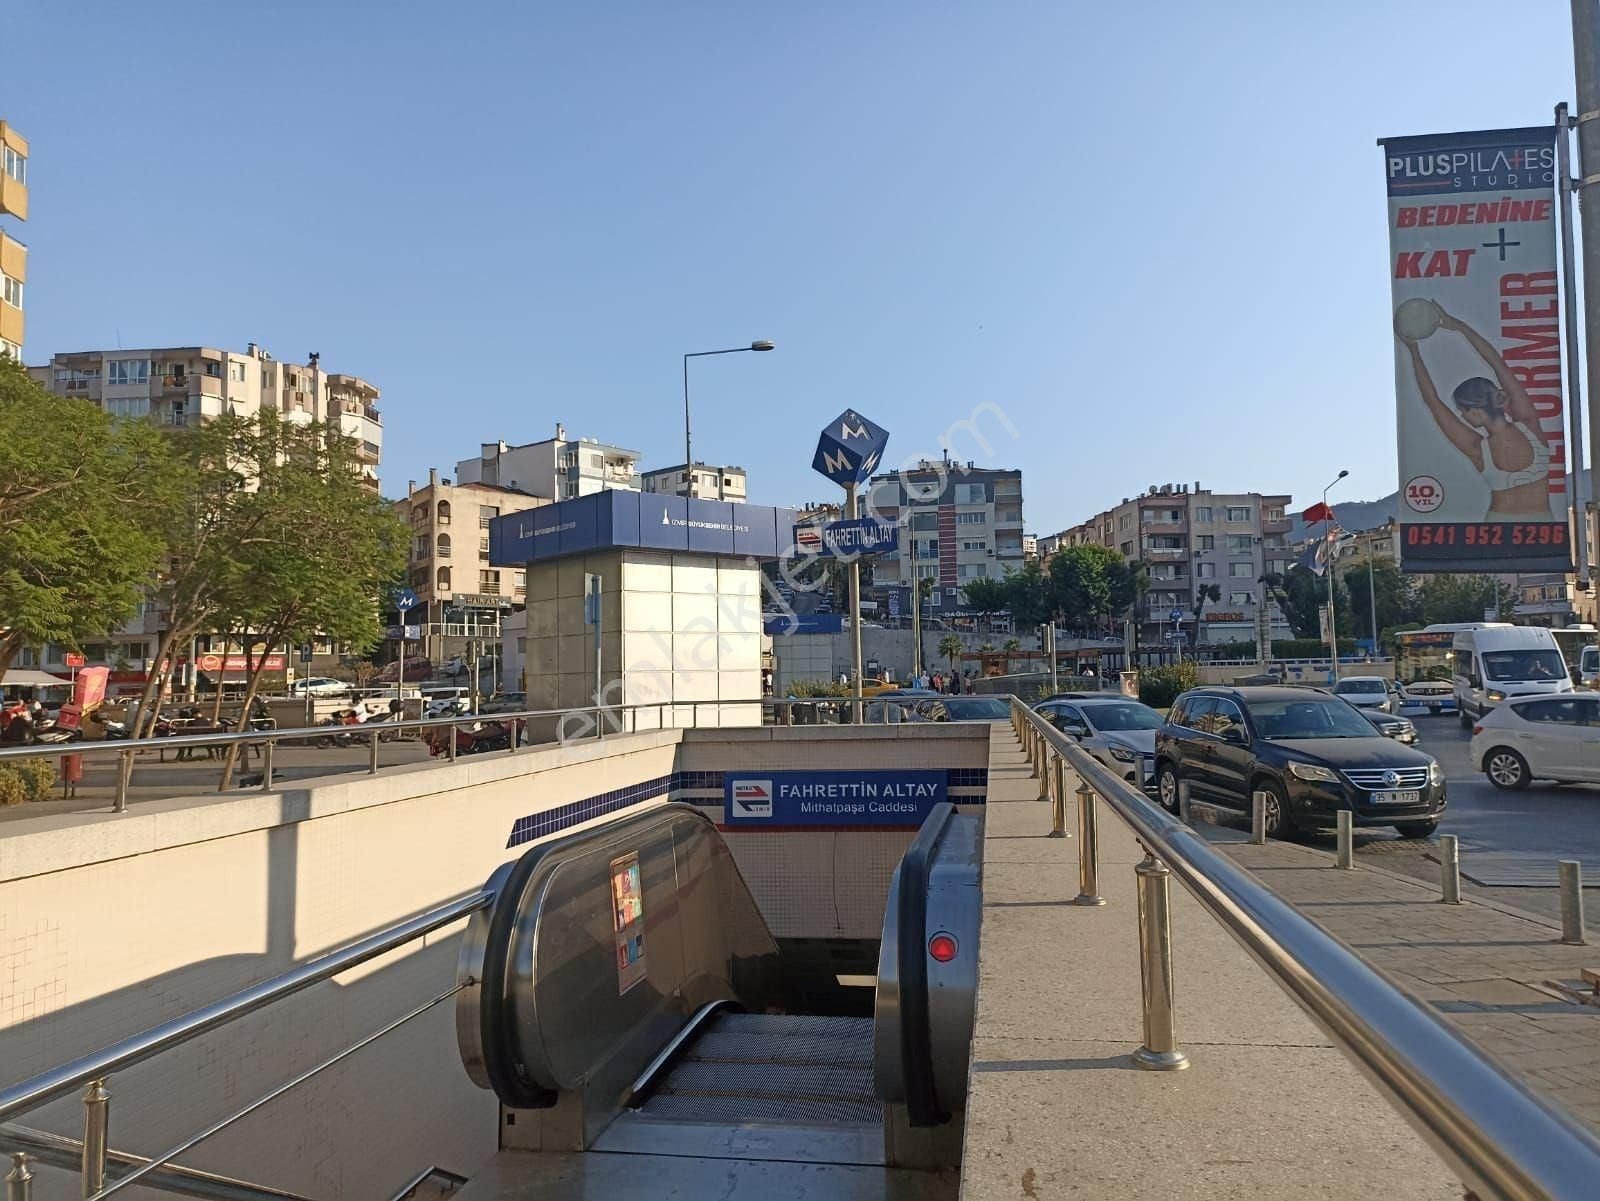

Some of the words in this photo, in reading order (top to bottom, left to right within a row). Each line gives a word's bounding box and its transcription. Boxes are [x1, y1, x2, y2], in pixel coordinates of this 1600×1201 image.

[1453, 172, 1553, 188] STUDIO
[1396, 196, 1552, 229] BEDENİNE
[1394, 249, 1476, 279] KAT
[842, 422, 872, 440] M
[823, 448, 853, 474] M
[825, 522, 868, 548] FAHRETTİN
[870, 524, 893, 544] ALTAY
[1408, 526, 1456, 545] 0541
[1465, 526, 1503, 545] 952
[1512, 525, 1564, 545] 5296
[780, 781, 877, 798] FAHRETTİN
[883, 783, 938, 798] ALTAY
[801, 801, 865, 815] Mithatpaşa
[868, 801, 917, 813] Caddesi
